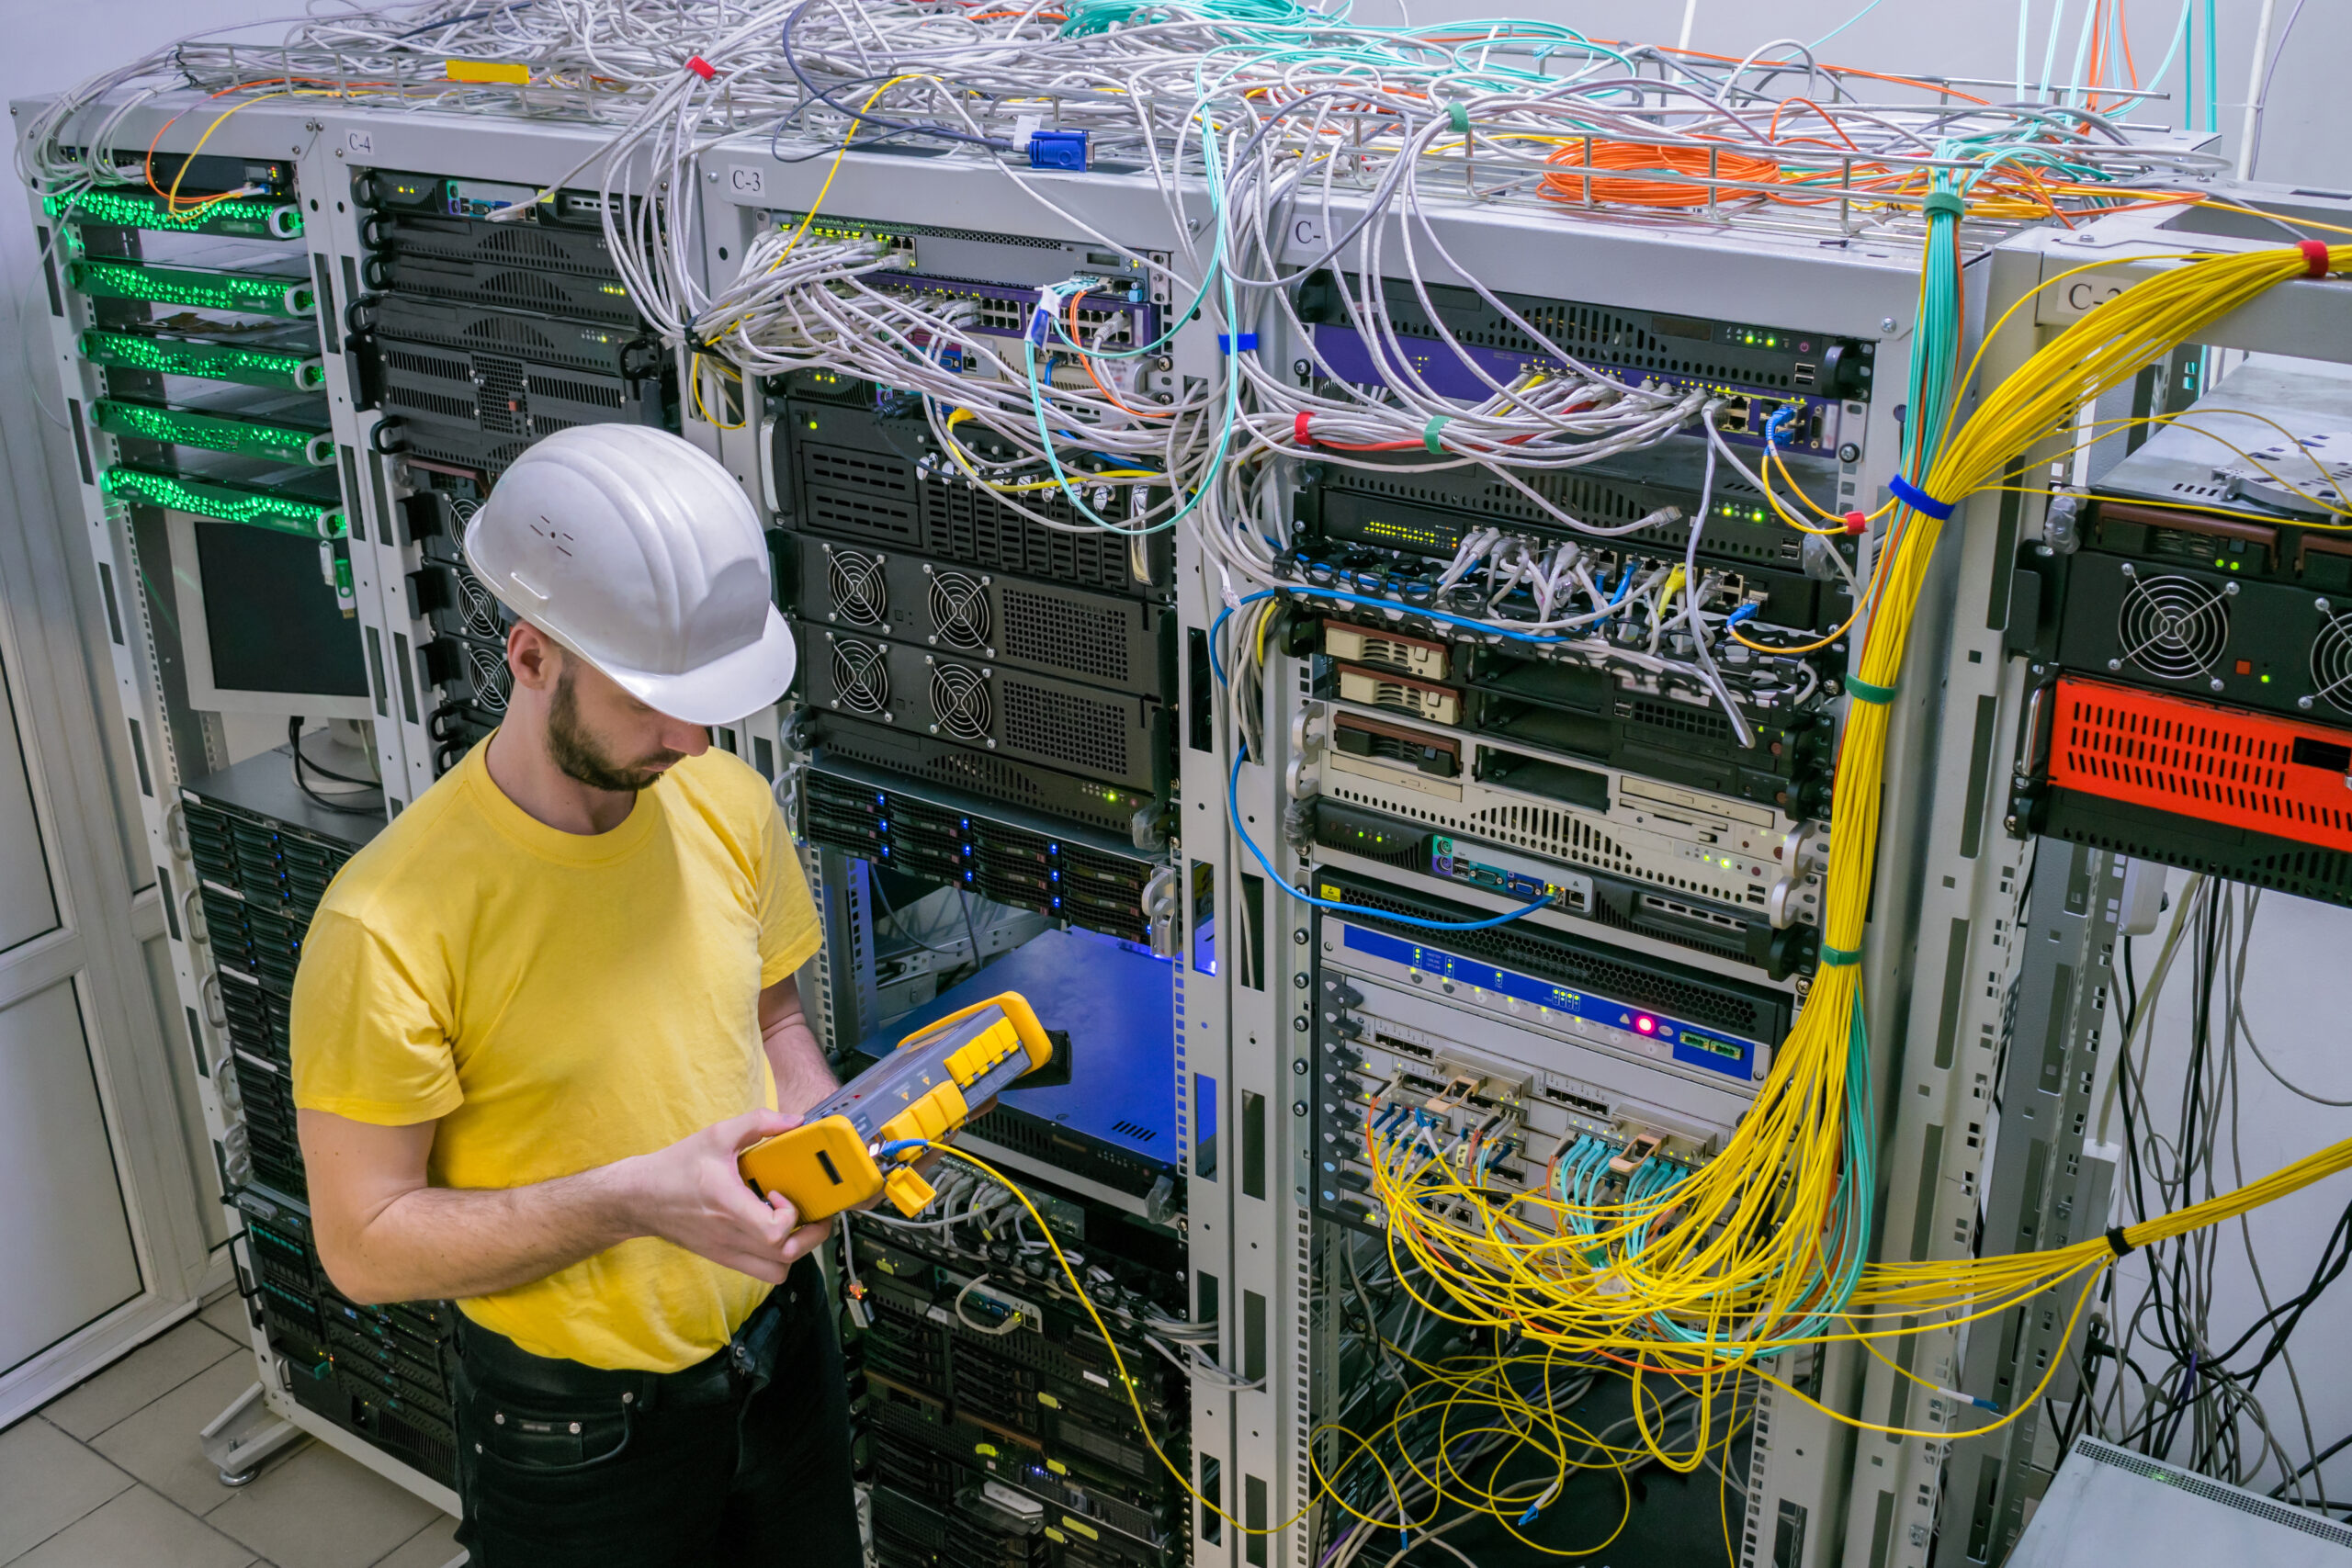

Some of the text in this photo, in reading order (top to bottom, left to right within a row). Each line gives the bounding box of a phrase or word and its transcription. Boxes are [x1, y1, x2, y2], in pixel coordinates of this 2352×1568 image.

[349, 132, 370, 153] C-4
[732, 169, 761, 192] C-3
[1295, 220, 1321, 244] C-
